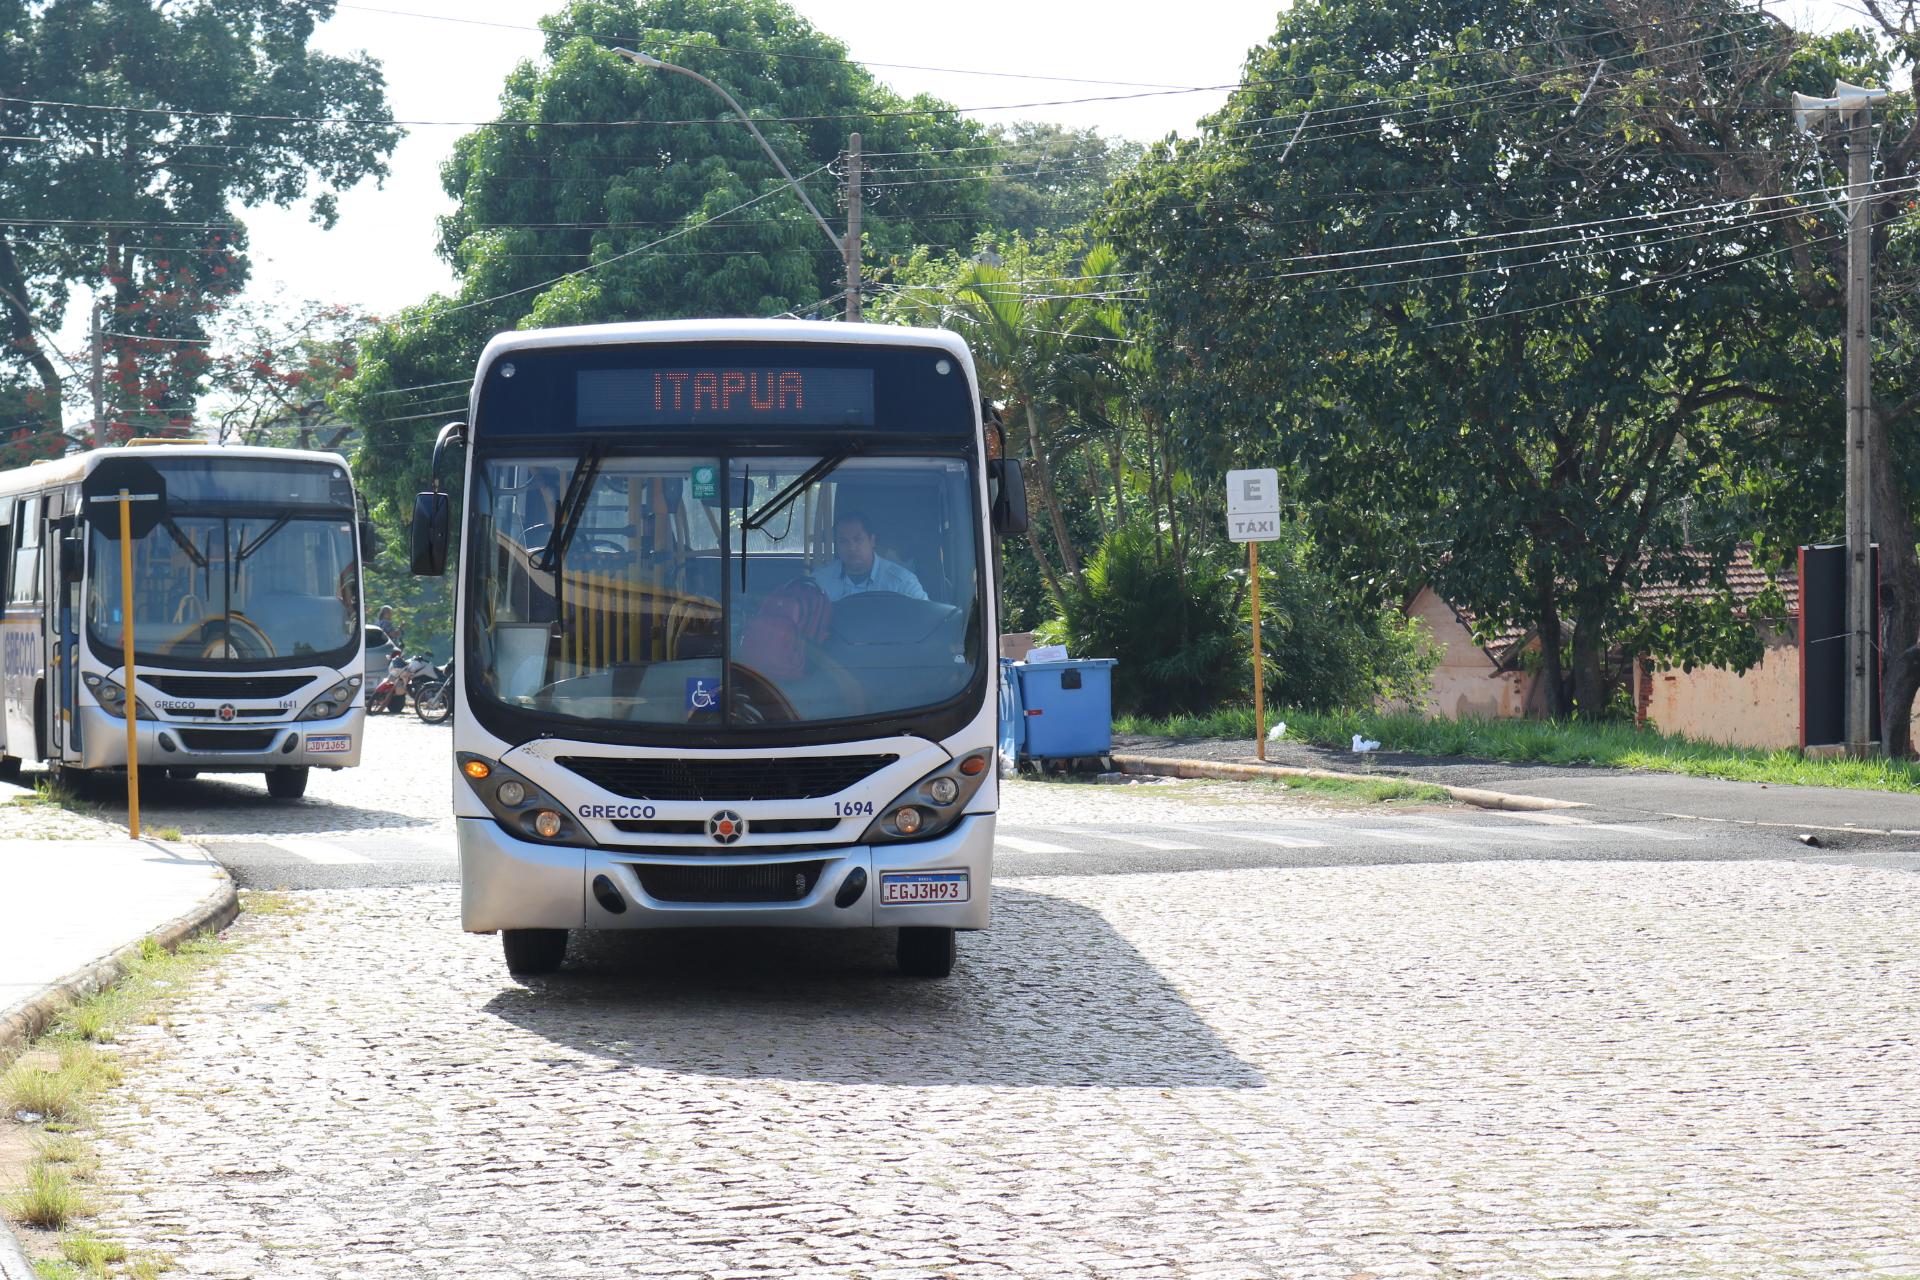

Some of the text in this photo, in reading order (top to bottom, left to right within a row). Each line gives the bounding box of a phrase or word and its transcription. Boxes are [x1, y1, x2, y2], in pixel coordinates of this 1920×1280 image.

[655, 372, 803, 410] ITAPUA
[1243, 479, 1262, 501] E
[4, 631, 36, 677] GRECCO
[154, 700, 196, 709] GRECCO
[278, 700, 297, 709] 1641
[578, 804, 656, 819] GRECCO
[834, 801, 874, 816] 1694
[889, 883, 959, 899] EGJ3H93
